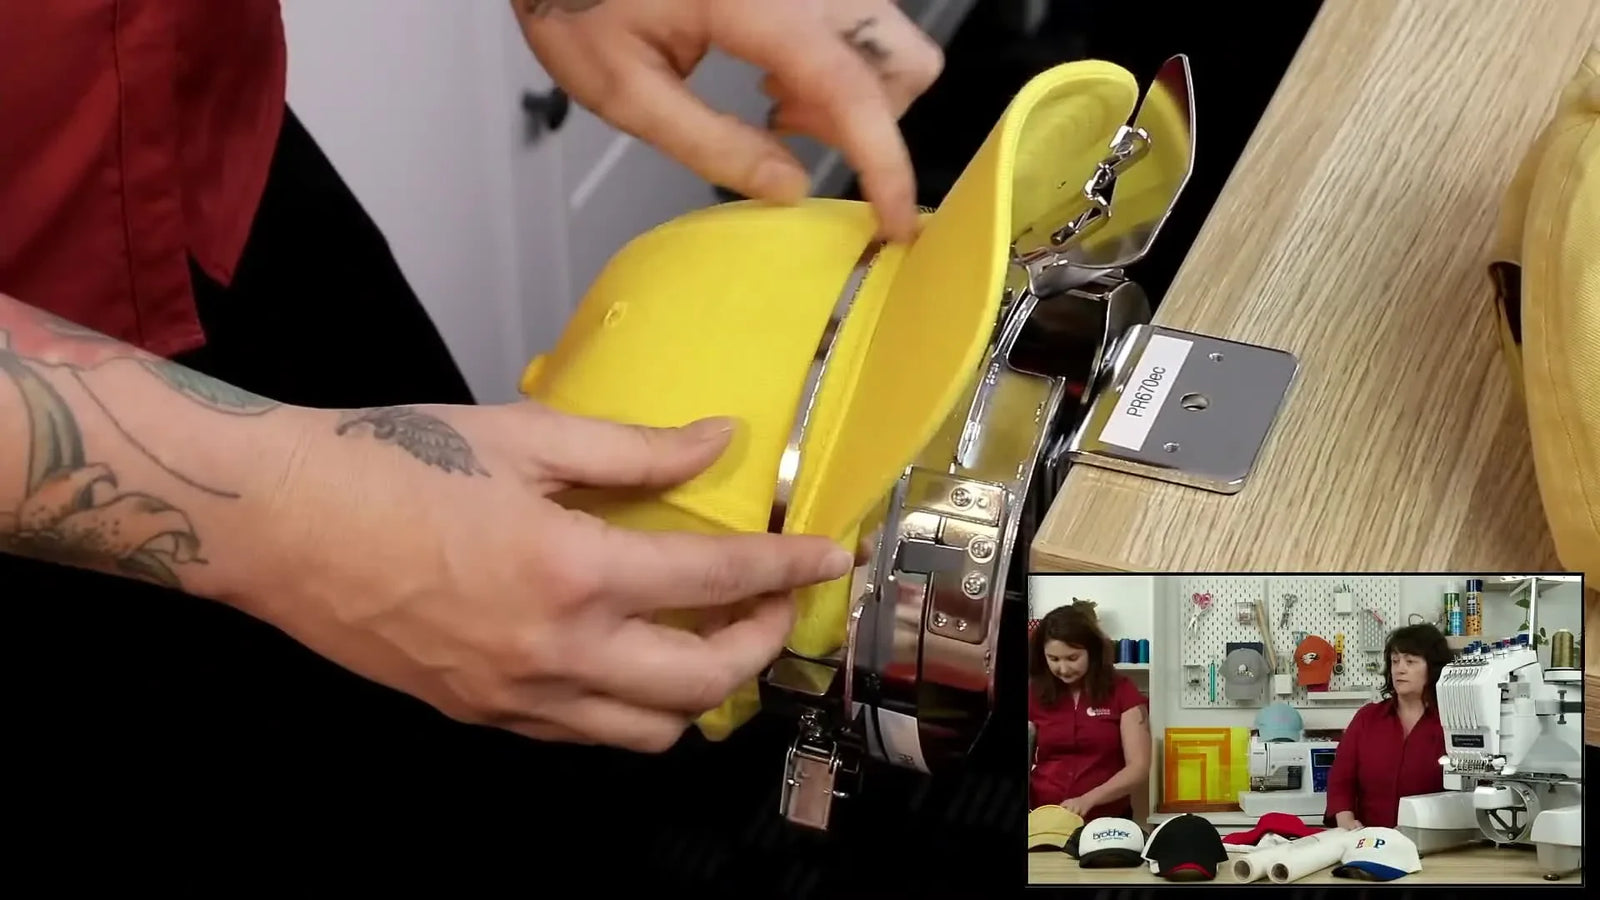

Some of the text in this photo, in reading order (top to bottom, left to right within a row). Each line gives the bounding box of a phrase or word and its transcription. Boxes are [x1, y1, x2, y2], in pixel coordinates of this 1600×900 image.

[1126, 366, 1166, 418] PR670ec
[1092, 828, 1130, 840] brother
[1356, 838, 1386, 849] EP
